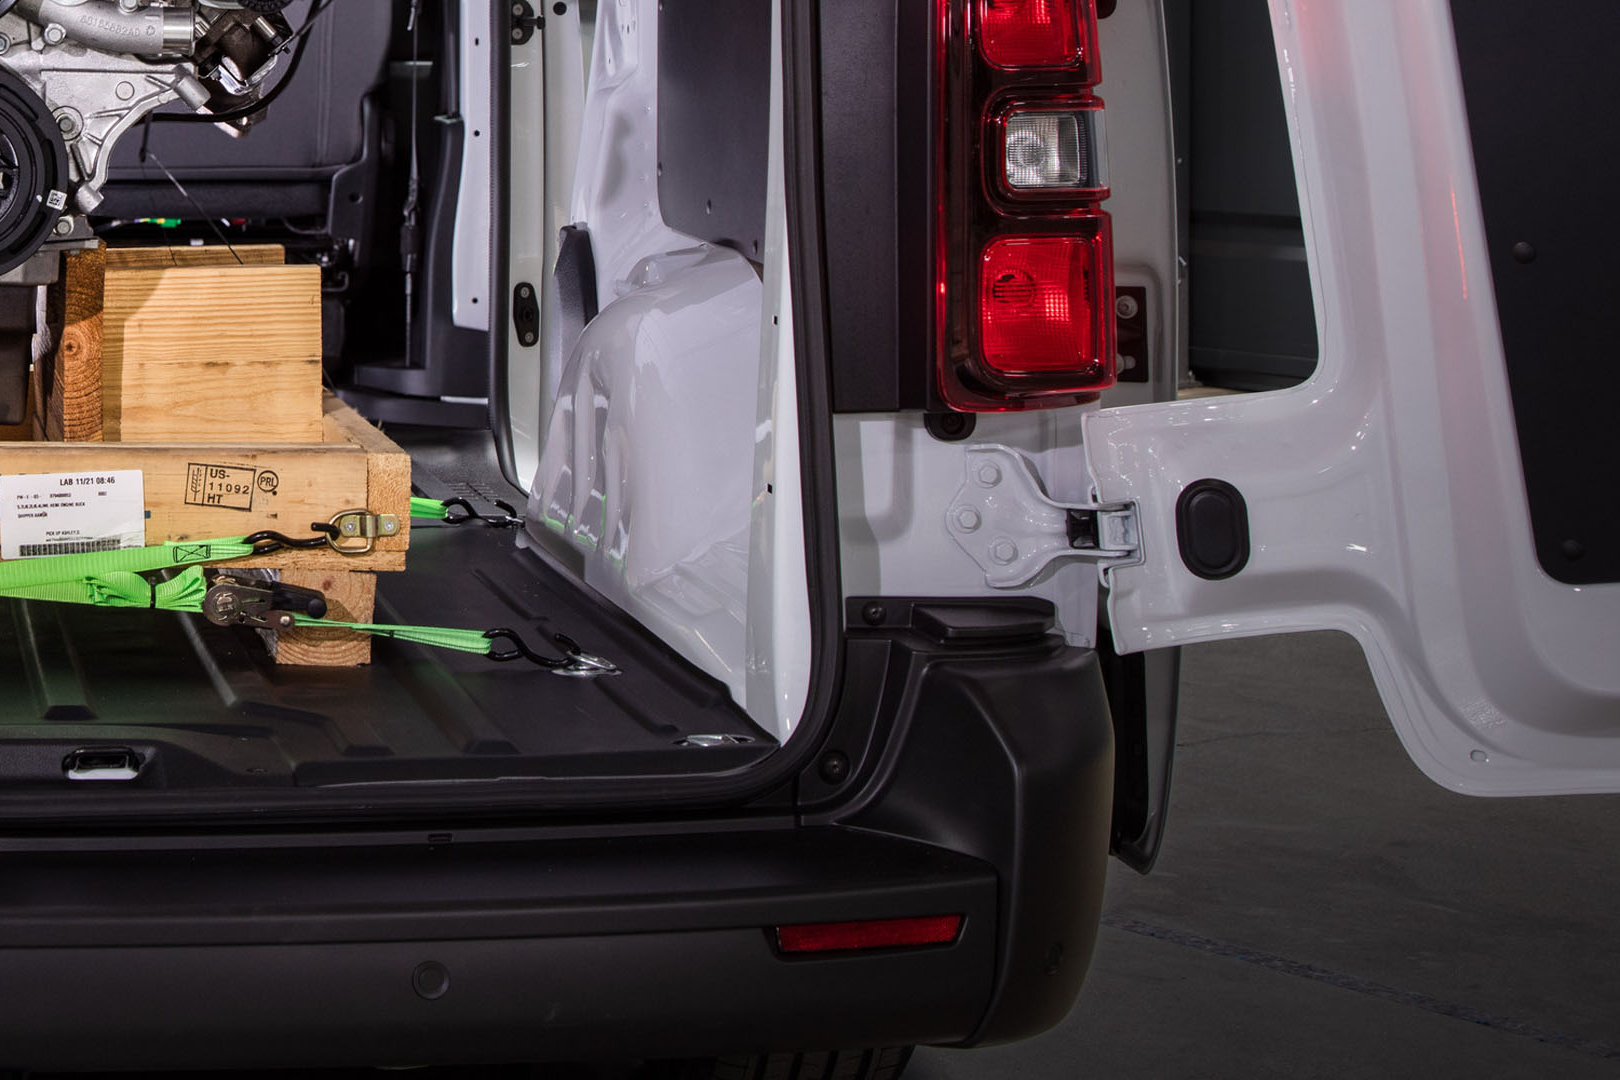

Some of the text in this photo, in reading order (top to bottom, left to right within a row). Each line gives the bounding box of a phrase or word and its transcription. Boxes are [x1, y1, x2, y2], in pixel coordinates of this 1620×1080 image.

[209, 468, 231, 479] US-
[60, 476, 116, 486] LAB 11/21 08:46
[259, 476, 276, 488] PRL
[208, 481, 250, 495] 11092
[207, 493, 224, 504] HT
